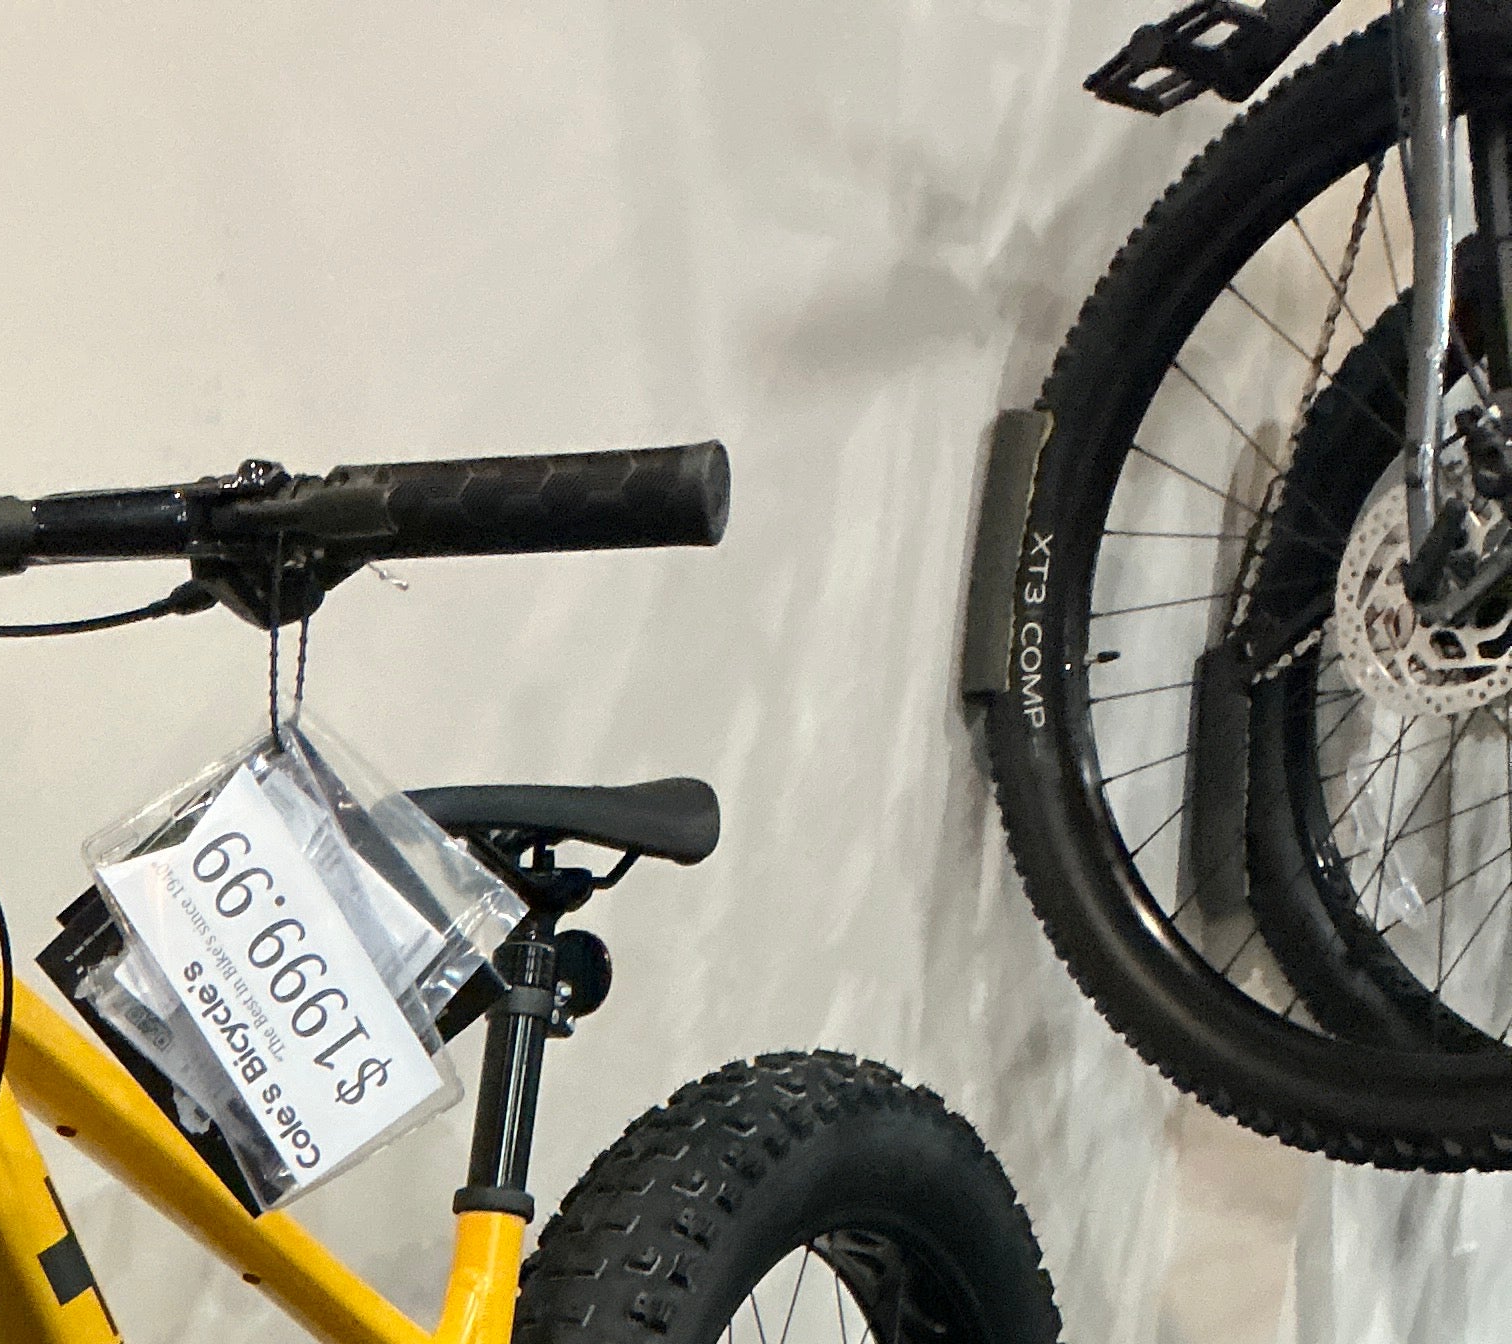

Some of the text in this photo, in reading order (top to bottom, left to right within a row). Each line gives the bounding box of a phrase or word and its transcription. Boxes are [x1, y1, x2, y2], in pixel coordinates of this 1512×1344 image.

[1020, 532, 1054, 728] XT3 COMP
[181, 900, 209, 935] since
[193, 832, 392, 1106] $1999.99
[206, 936, 237, 981] Bike's
[233, 978, 248, 997] in
[243, 996, 268, 1029] Best
[184, 962, 321, 1169] Cole's Bicycle's
